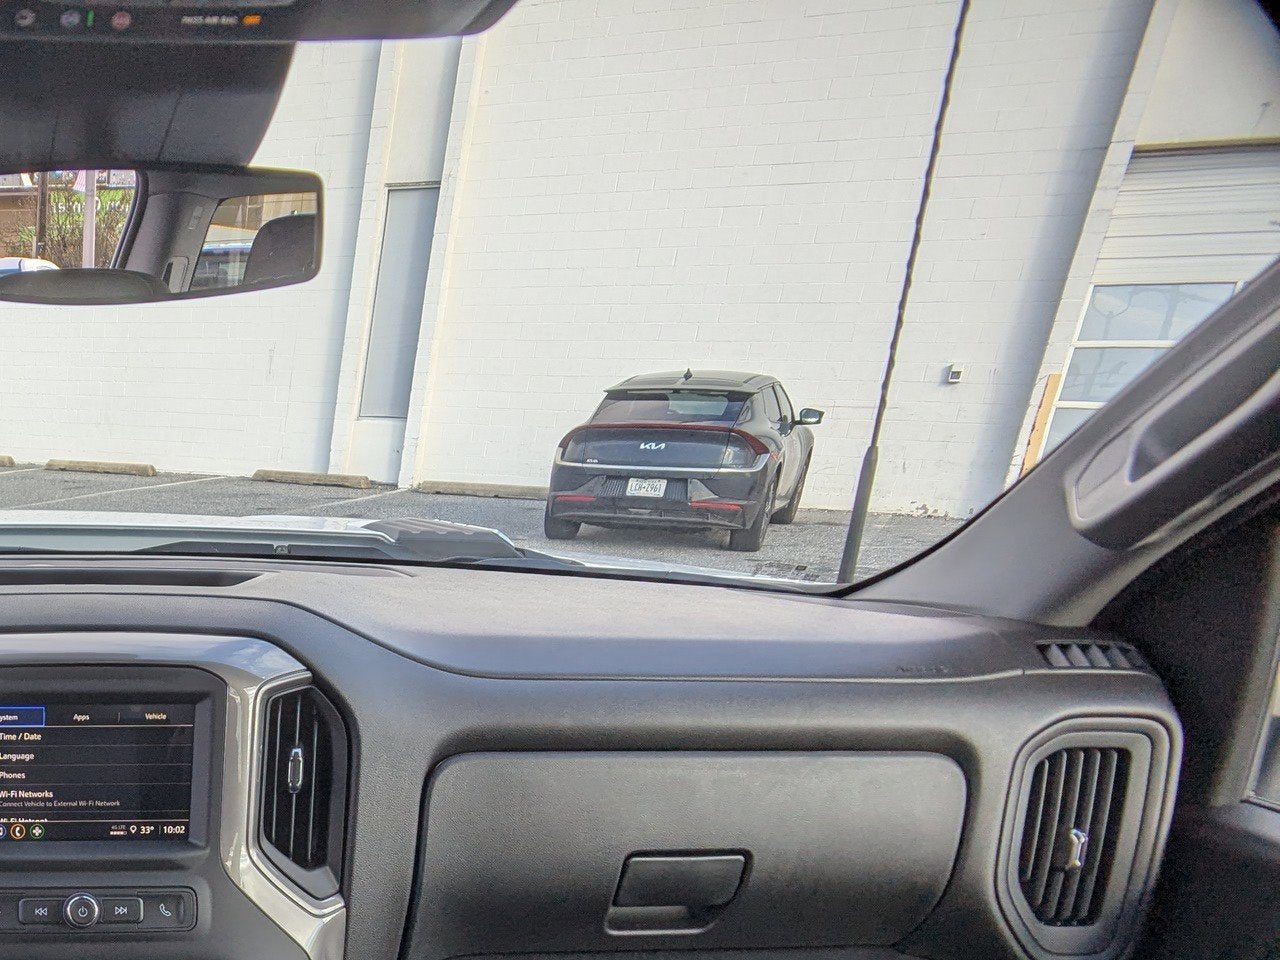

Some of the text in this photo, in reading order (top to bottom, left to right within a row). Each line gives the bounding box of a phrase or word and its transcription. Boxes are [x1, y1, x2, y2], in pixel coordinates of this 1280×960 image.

[73, 713, 90, 722] Apps
[144, 712, 167, 720] Vehicle
[24, 733, 42, 741] Date
[18, 790, 54, 798] Networks
[163, 825, 186, 834] 10:02
